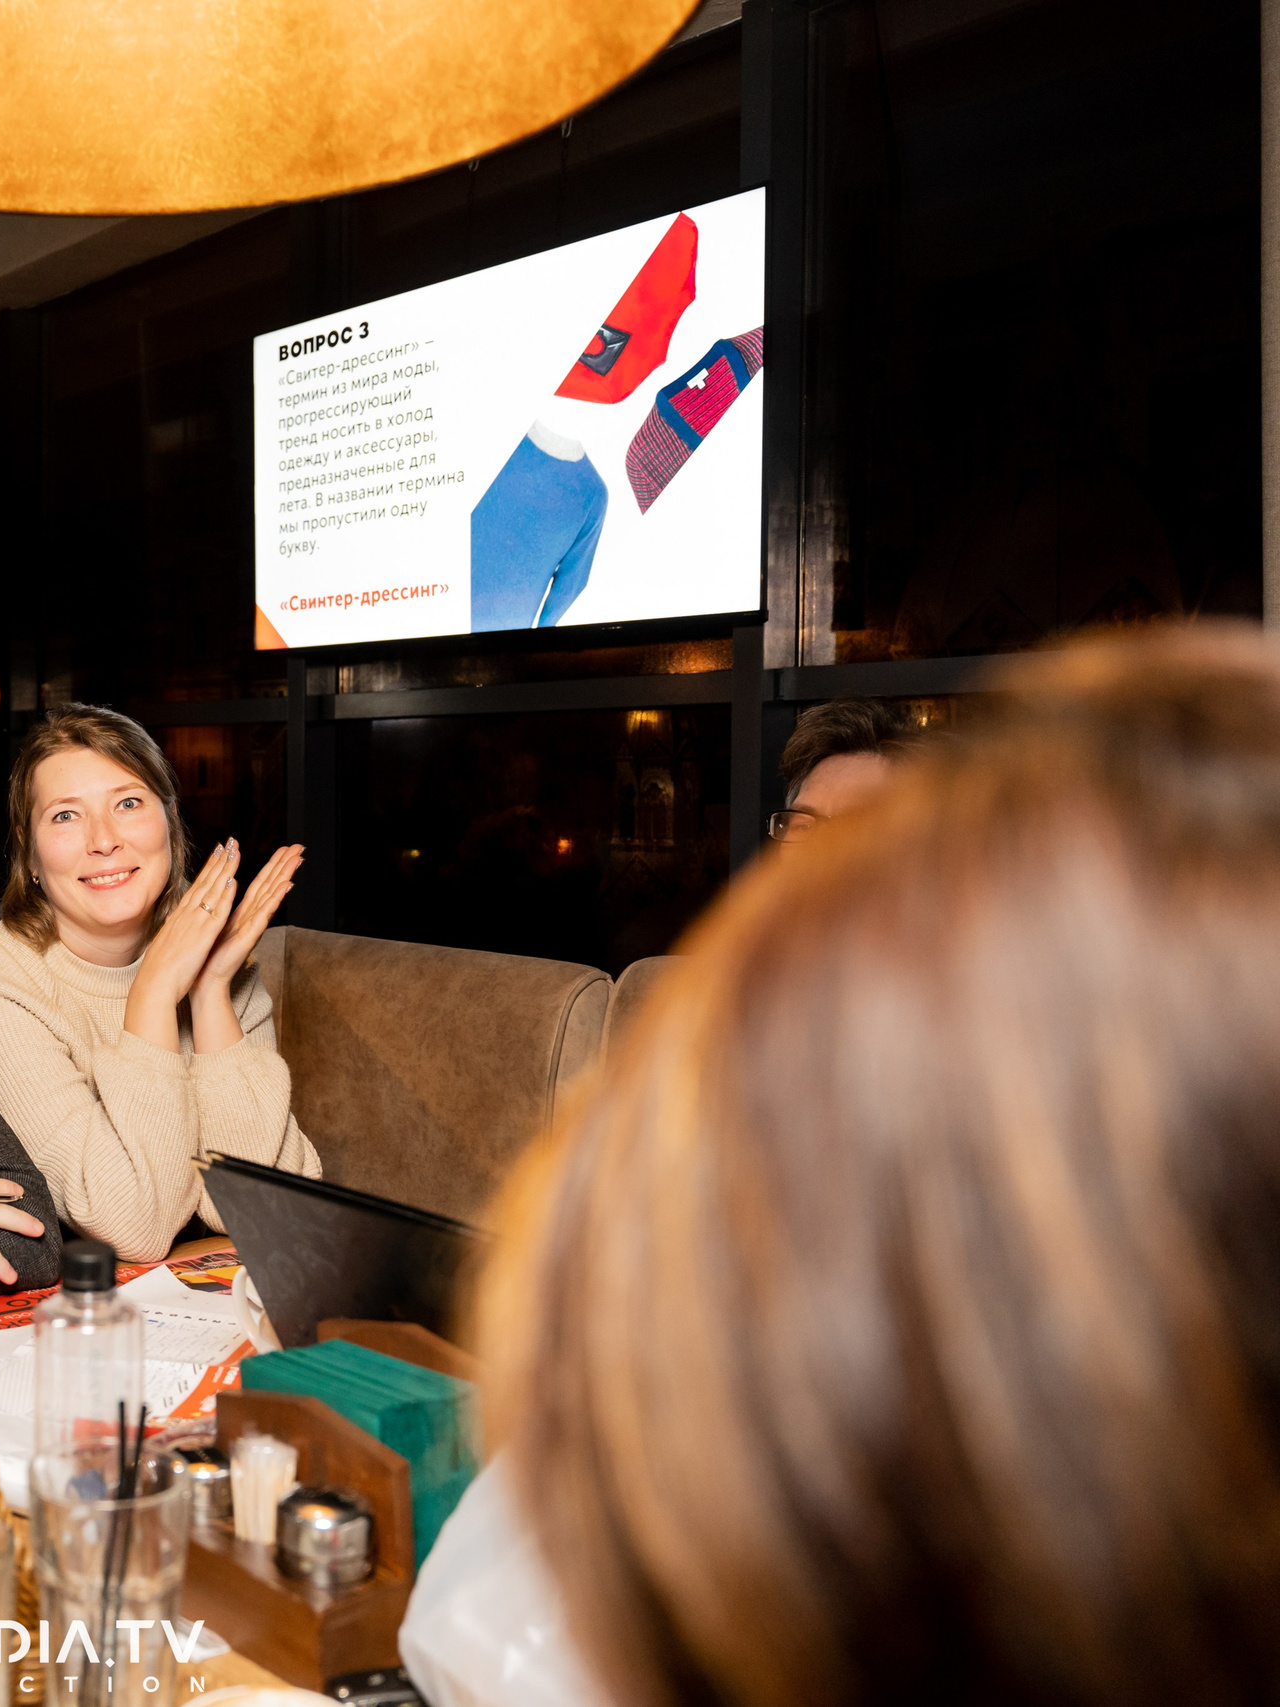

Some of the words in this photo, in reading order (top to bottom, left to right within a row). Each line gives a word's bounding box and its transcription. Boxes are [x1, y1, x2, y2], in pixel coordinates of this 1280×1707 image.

[278, 326, 353, 362] ВОПРОС
[359, 321, 370, 339] 3
[278, 341, 420, 386] «Свитер-дрессинг»
[278, 386, 332, 409] термин
[332, 382, 347, 397] из
[351, 371, 388, 391] мира
[392, 360, 440, 383] моды,
[278, 385, 412, 431] прогрессирующий
[278, 432, 318, 453] тренд
[322, 421, 371, 442] носить
[375, 418, 383, 430] в
[387, 407, 434, 427] холод
[278, 450, 330, 472] одежду
[334, 447, 342, 460] и
[346, 429, 438, 459] аксессуары,
[278, 458, 405, 494] предназначенные
[409, 452, 437, 470] для
[278, 497, 311, 513] лета.
[315, 492, 324, 507] В
[327, 482, 394, 505] названии
[398, 470, 465, 494] термина
[279, 519, 299, 534] мы
[302, 507, 386, 533] пропустили
[390, 500, 428, 517] одну
[278, 539, 320, 558] букву.
[280, 583, 450, 611] «Свинтер-дрессинг»
